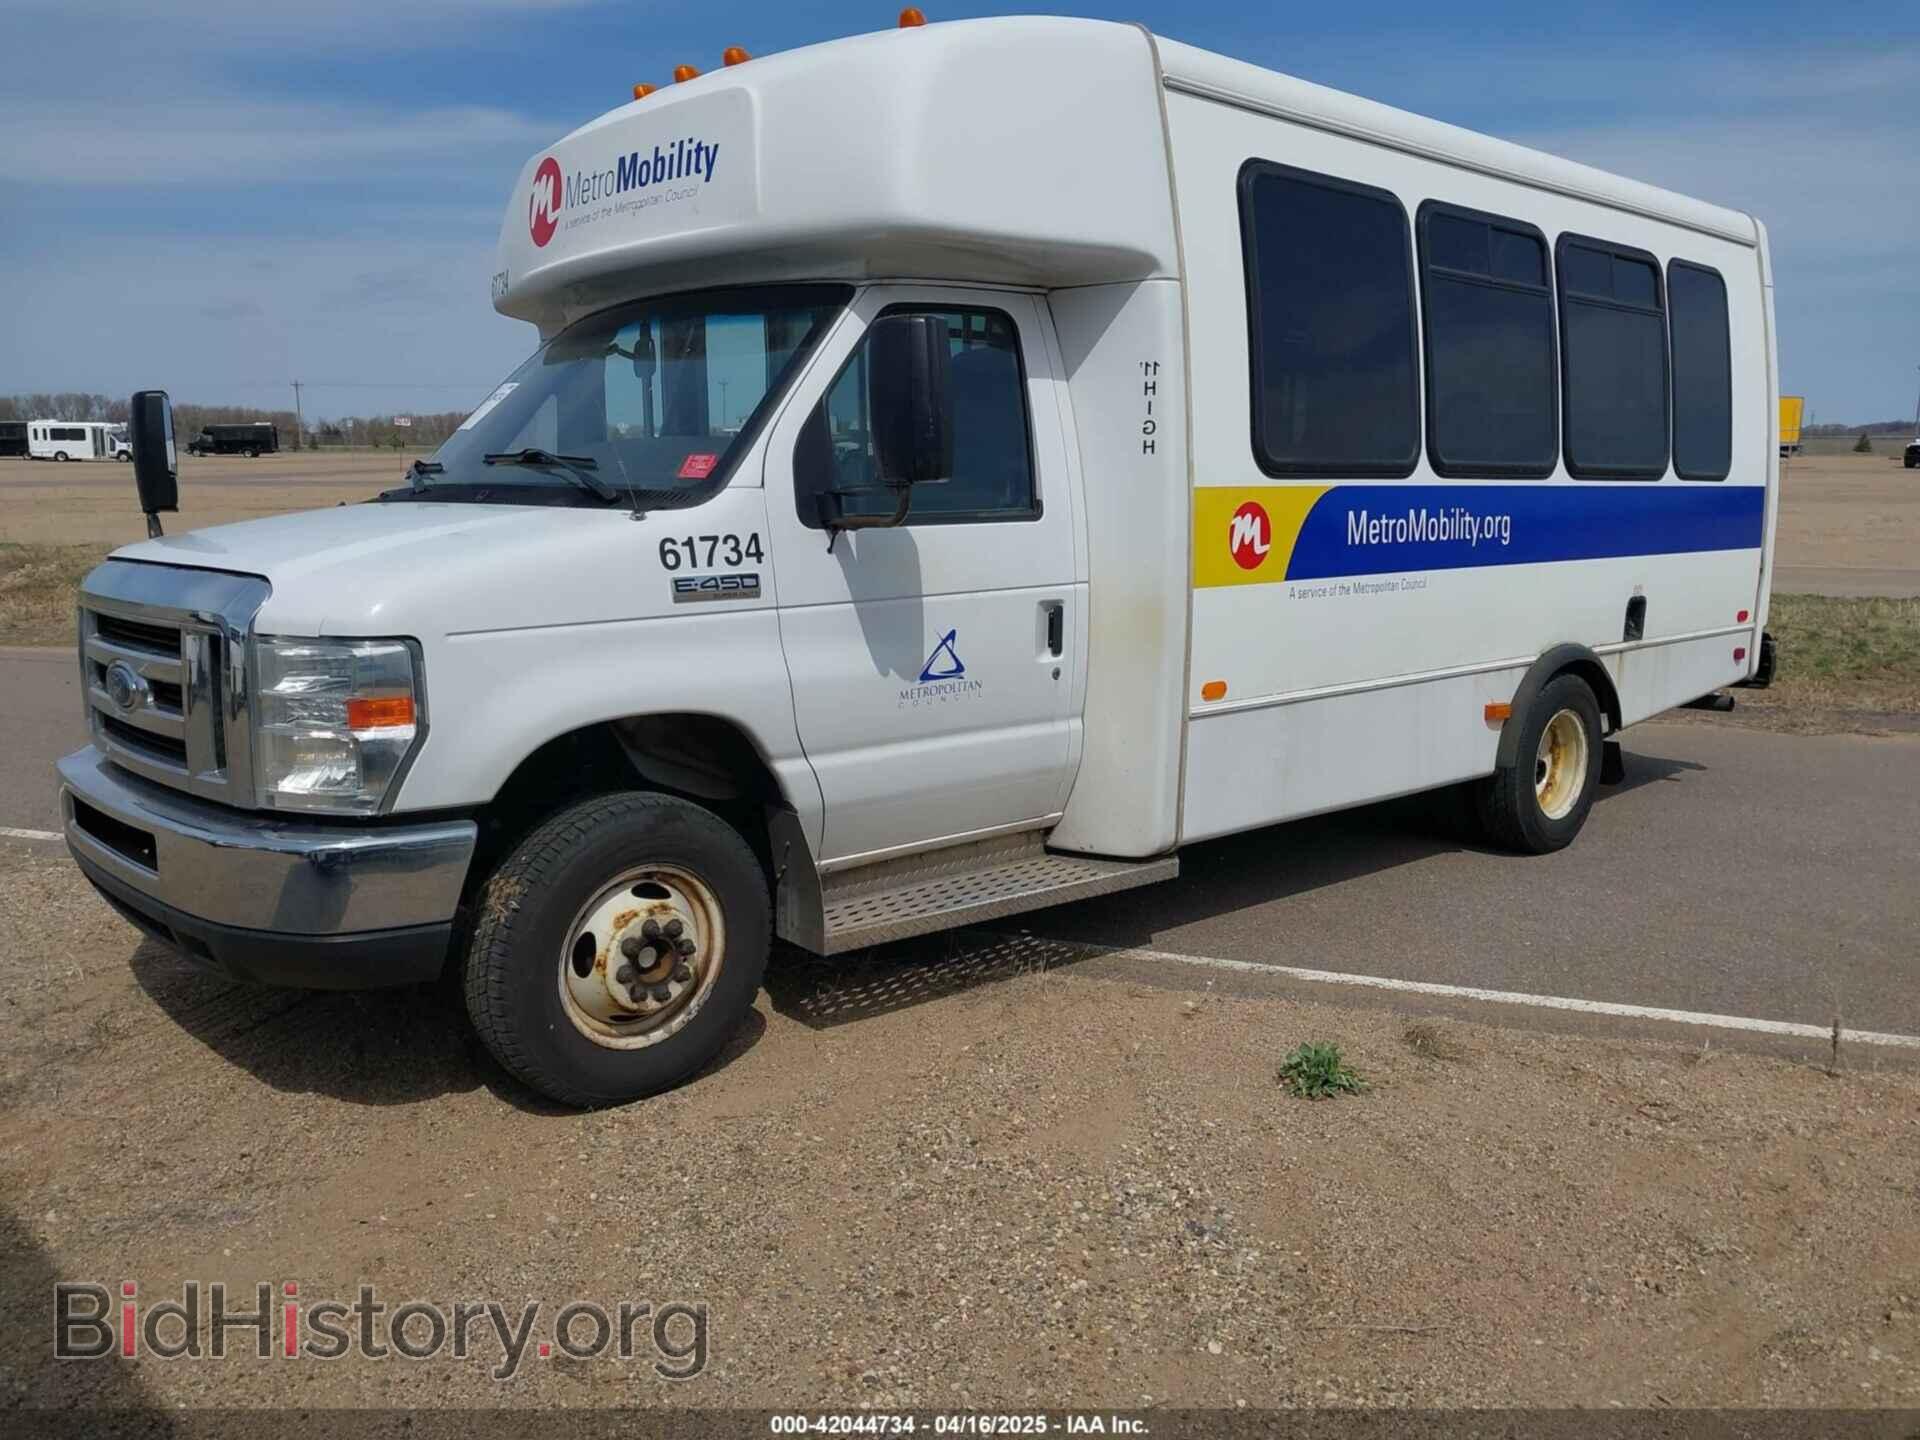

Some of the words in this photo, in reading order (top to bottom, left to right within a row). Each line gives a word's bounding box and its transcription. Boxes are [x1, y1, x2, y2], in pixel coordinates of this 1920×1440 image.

[565, 137, 719, 211] MetroMobility
[1347, 508, 1511, 547] MetroMobility.org
[659, 532, 764, 571] 61734
[1289, 586, 1296, 600] A
[1298, 587, 1327, 599] service
[1329, 585, 1338, 597] of
[1338, 583, 1351, 596] the
[1353, 580, 1400, 595] Metropolitan
[1401, 578, 1427, 591] Council
[900, 680, 983, 701] METROPOLITAN
